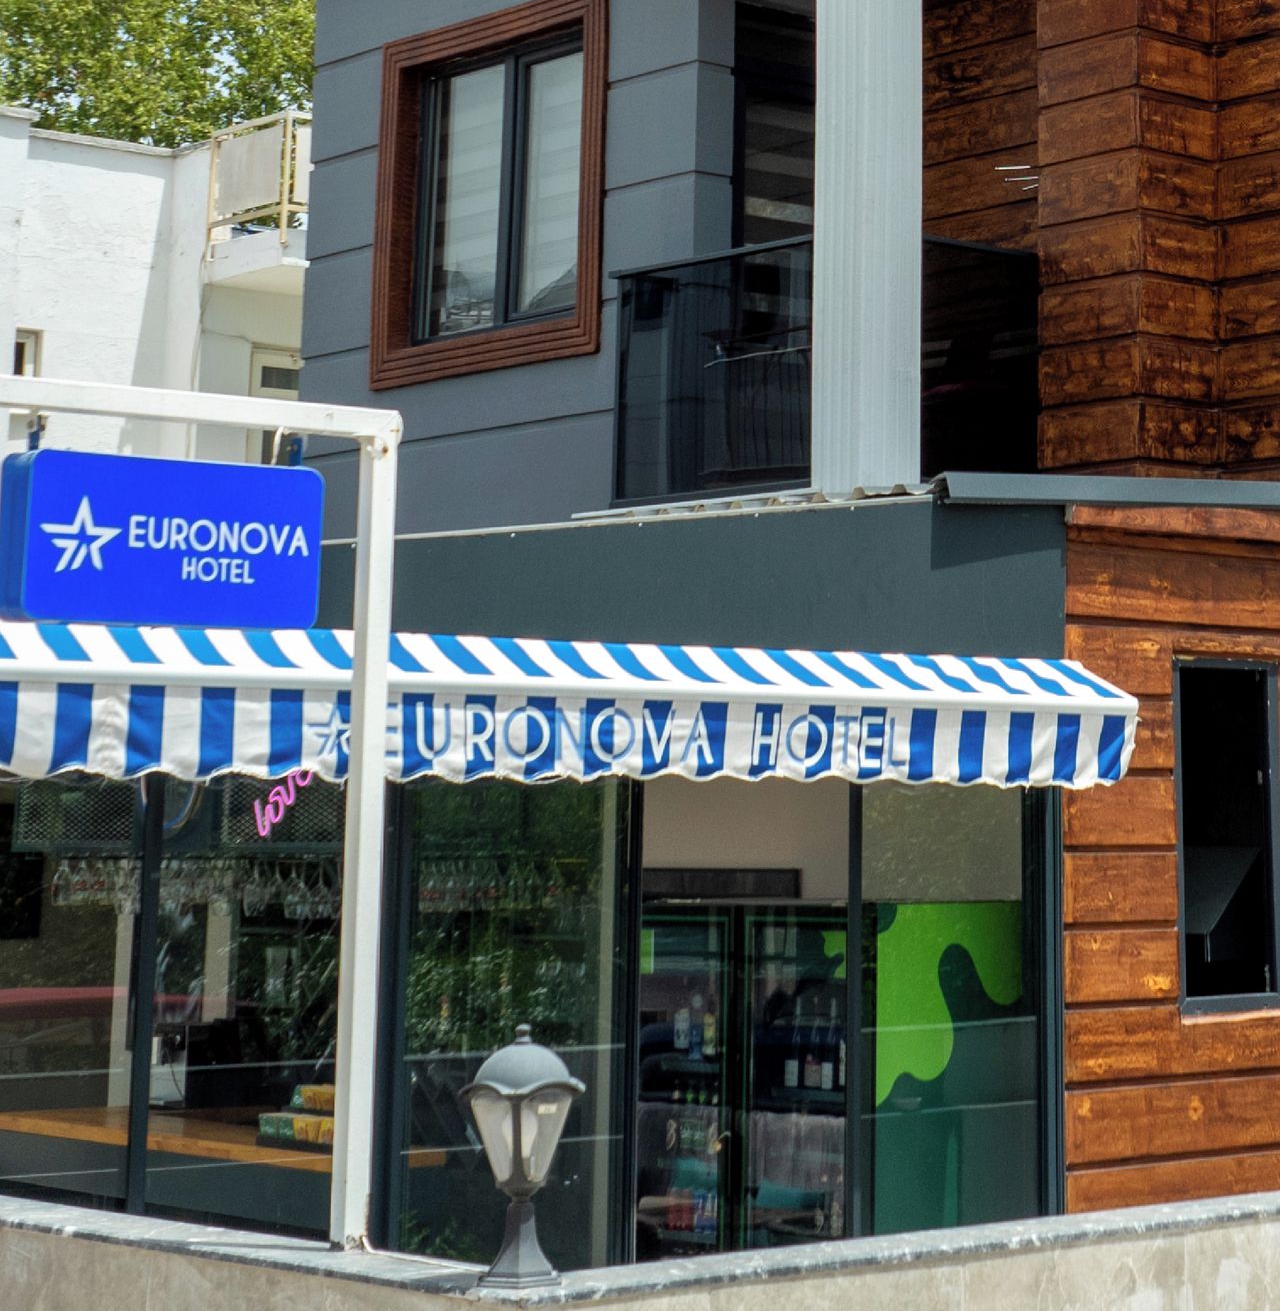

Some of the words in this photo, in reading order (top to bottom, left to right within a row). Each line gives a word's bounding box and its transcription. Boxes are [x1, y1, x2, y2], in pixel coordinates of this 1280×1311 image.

[128, 515, 309, 558] EURONOVA
[181, 556, 255, 585] HOTEL
[753, 712, 908, 768] HOTEL
